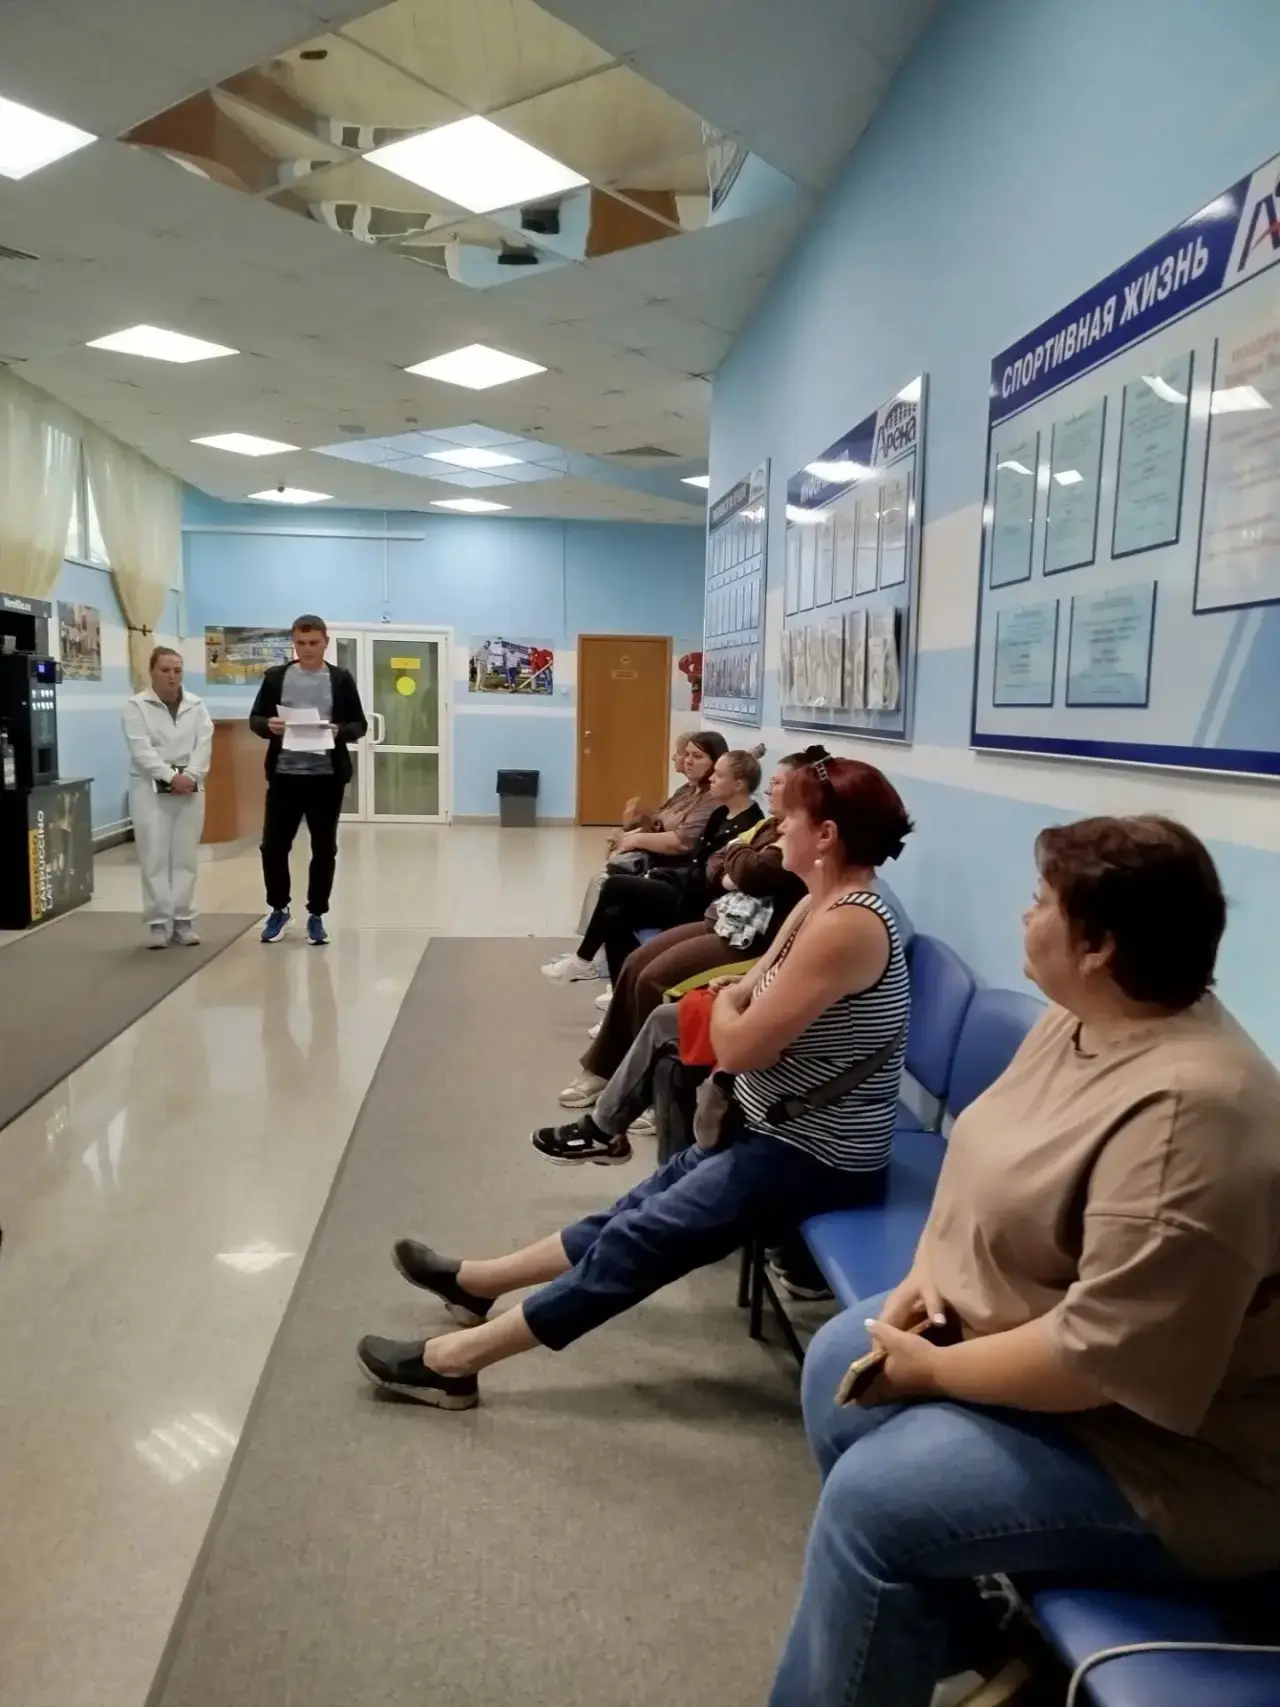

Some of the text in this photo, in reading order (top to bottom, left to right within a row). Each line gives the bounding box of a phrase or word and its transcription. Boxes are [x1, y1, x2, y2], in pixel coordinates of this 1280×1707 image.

[1001, 236, 1210, 400] СПОРТИВНАЯ ЖИЗНЬ
[873, 415, 917, 468] Арена
[37, 810, 47, 912] CAPPUCCINO
